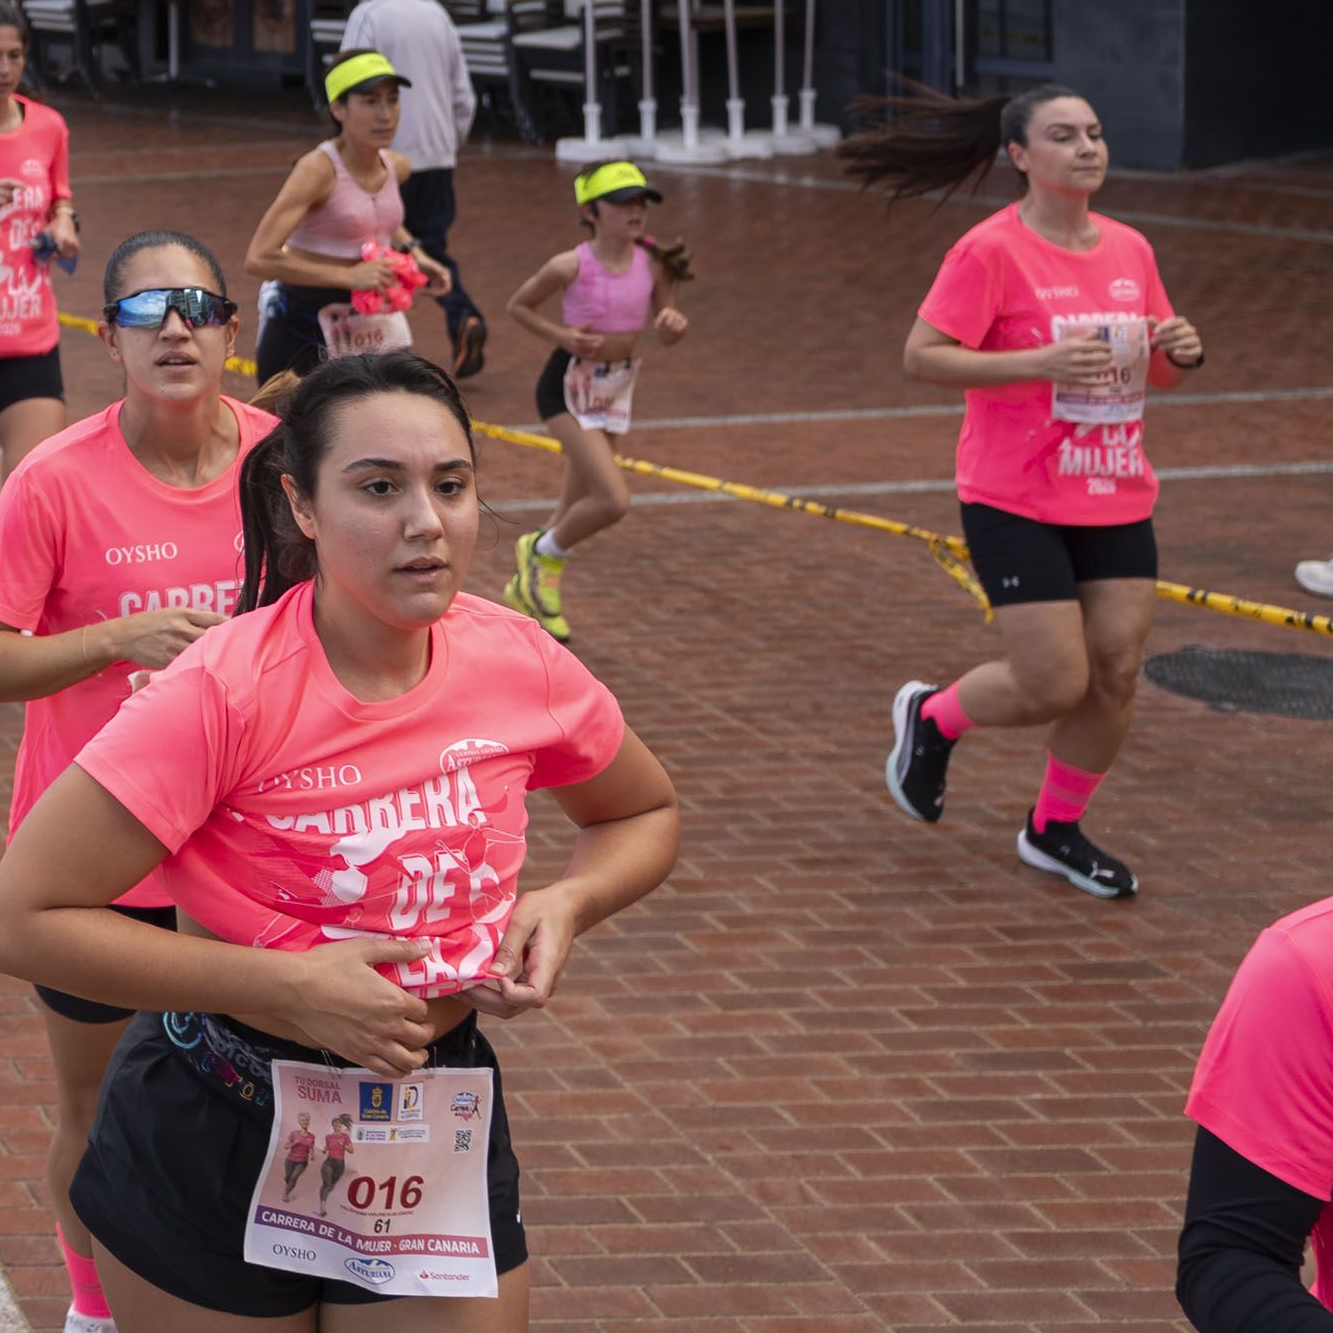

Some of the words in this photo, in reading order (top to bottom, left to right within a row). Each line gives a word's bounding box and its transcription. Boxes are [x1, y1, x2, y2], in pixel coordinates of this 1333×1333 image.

[354, 328, 383, 348] 016
[1057, 445, 1144, 476] MUJER
[105, 542, 178, 565] OYSHO
[294, 1075, 306, 1086] TU
[306, 1078, 341, 1091] DORSAL
[297, 1086, 342, 1104] SUMA
[347, 1175, 424, 1210] 016
[261, 1211, 315, 1232] CARRERA
[318, 1224, 335, 1238] DE
[337, 1231, 353, 1246] LA
[356, 1238, 391, 1252] MUJER
[399, 1239, 424, 1251] GRAN
[427, 1239, 480, 1254] CANARIA
[374, 1218, 391, 1234] 61
[272, 1243, 316, 1261] OYSHO
[430, 1272, 470, 1281] Santander
